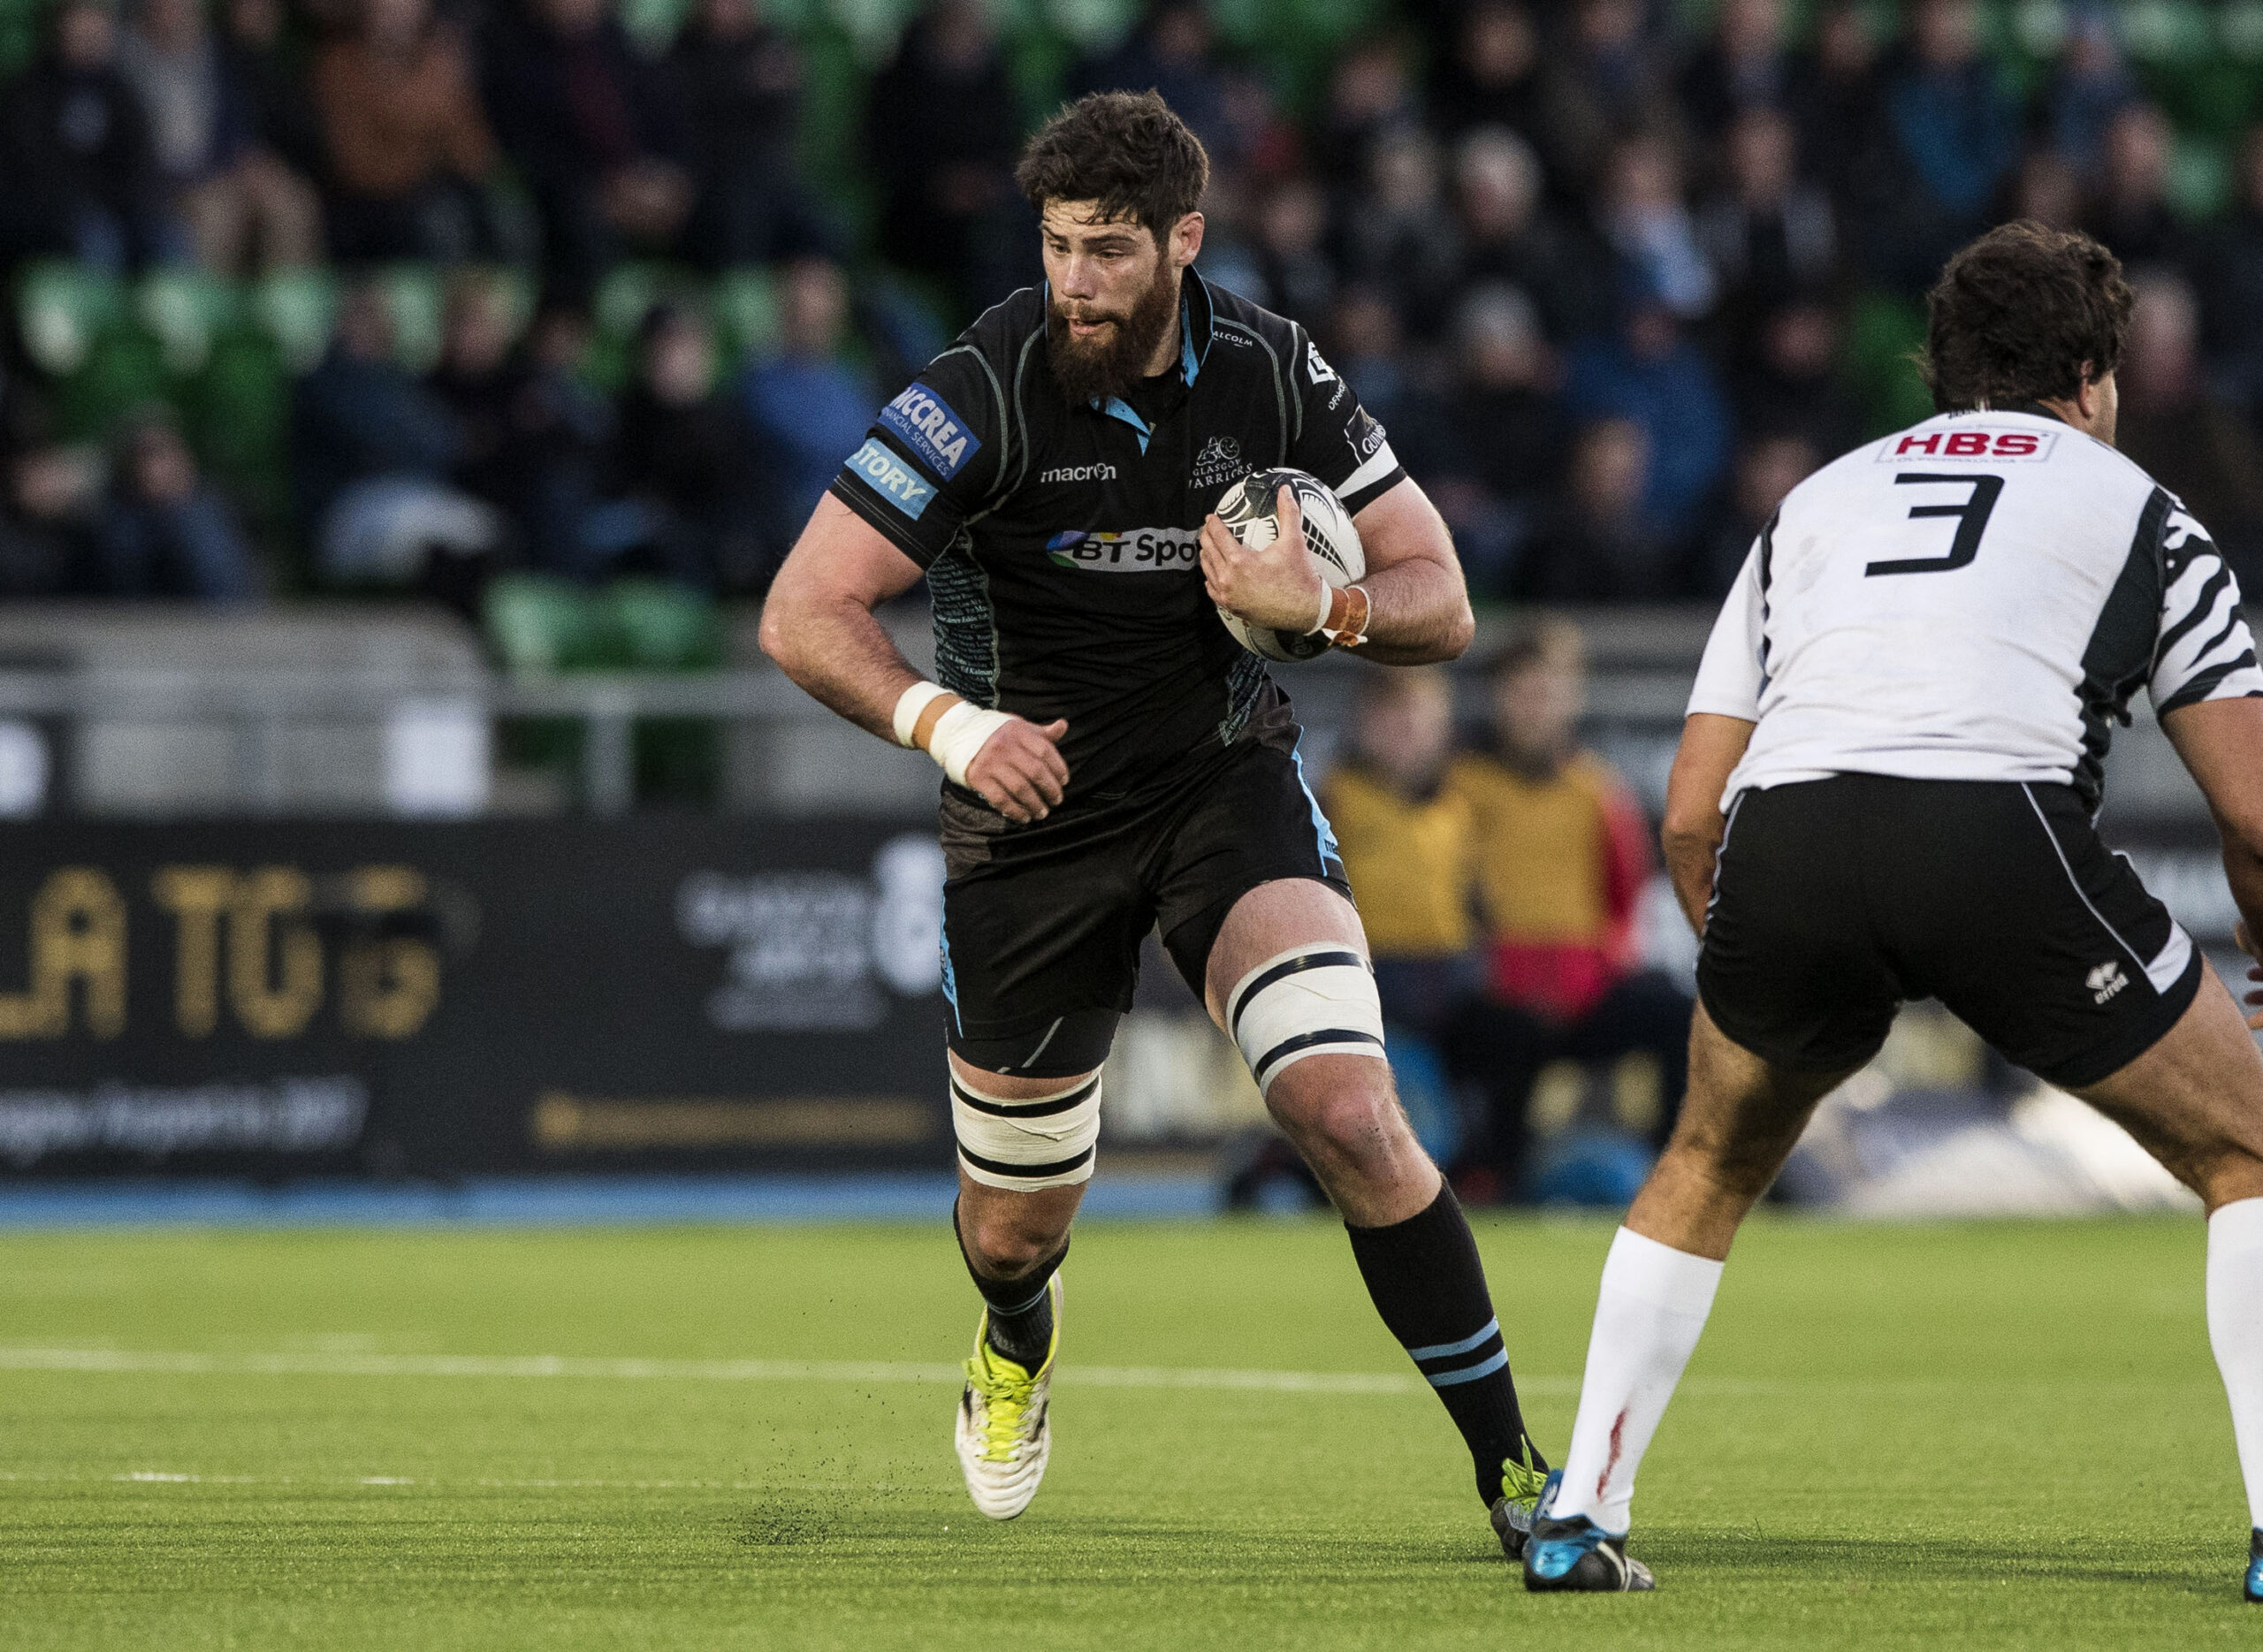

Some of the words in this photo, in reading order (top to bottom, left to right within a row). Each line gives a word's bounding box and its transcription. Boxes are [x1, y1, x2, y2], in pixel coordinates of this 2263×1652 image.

[911, 431, 950, 476] SERVICES
[1895, 432, 2039, 456] HBS
[1040, 463, 1116, 483] macron
[1864, 472, 2005, 577] 3
[1072, 540, 1131, 563] BT
[1135, 534, 1200, 566] Spo
